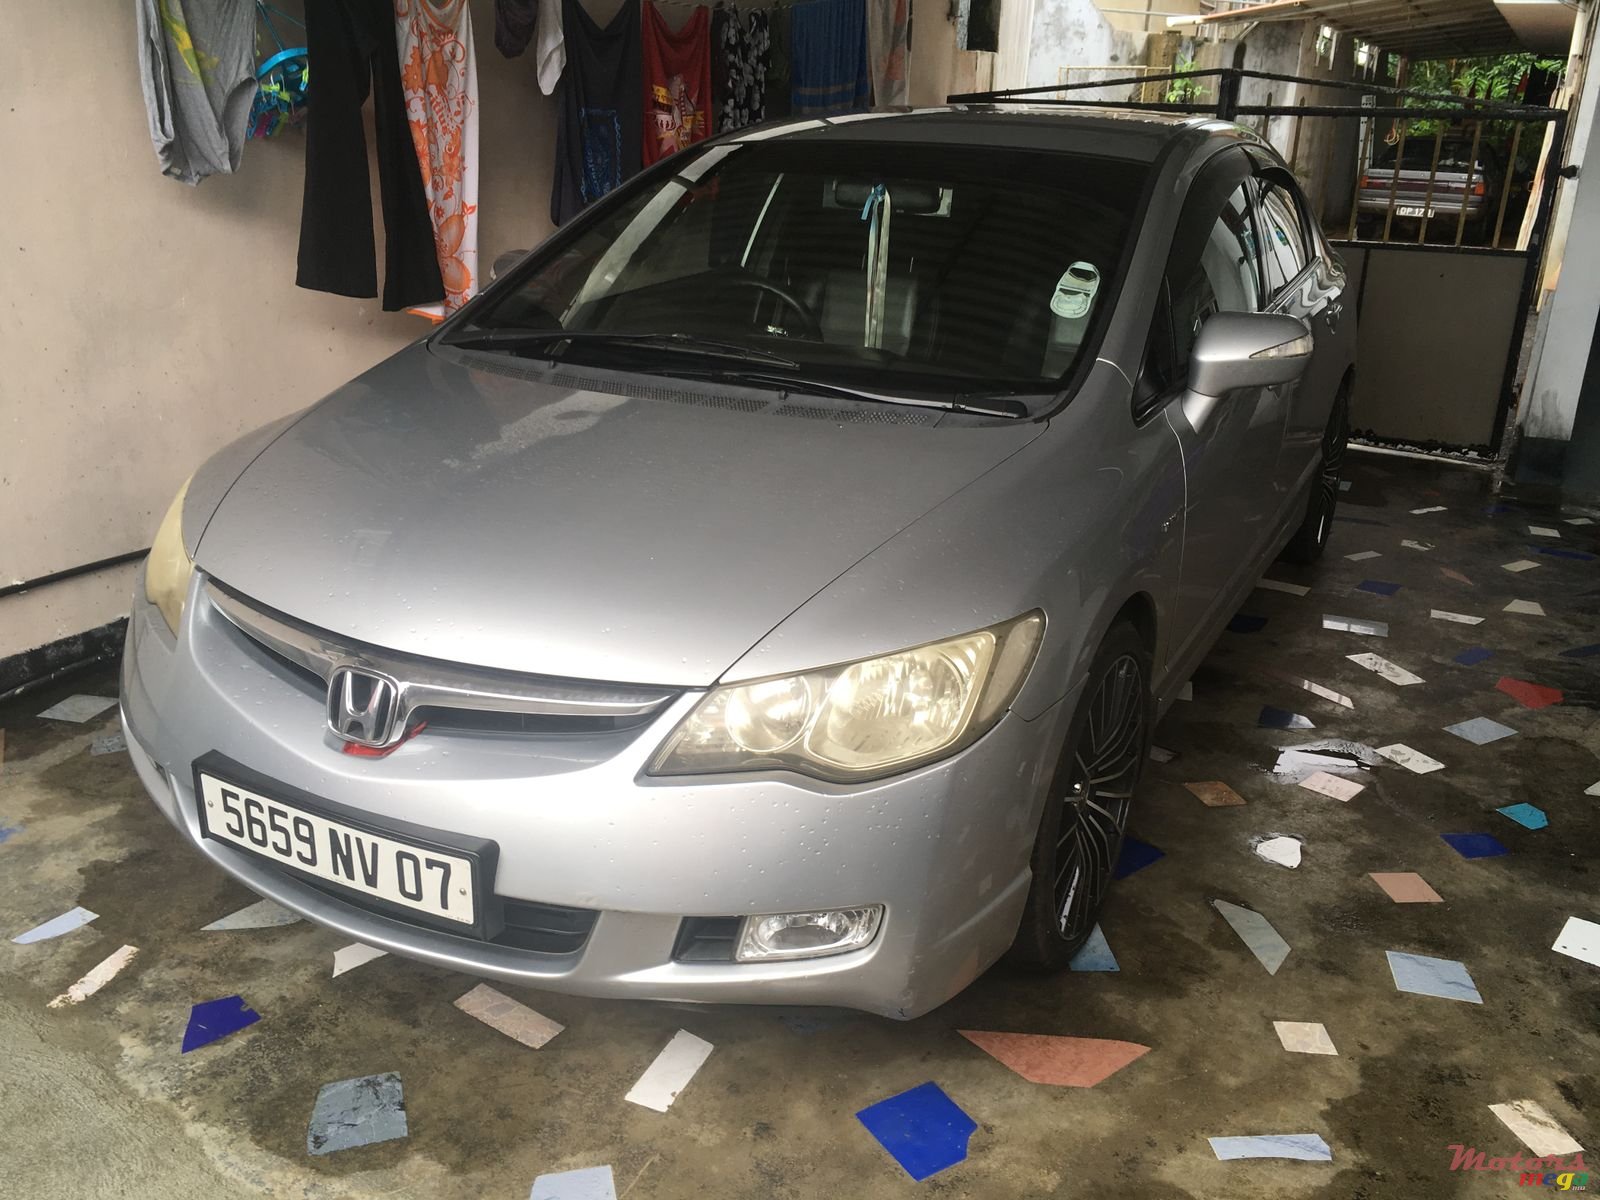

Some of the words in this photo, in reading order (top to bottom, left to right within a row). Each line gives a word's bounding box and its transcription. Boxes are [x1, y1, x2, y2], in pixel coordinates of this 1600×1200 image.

[221, 788, 317, 866] 5659
[328, 828, 379, 889] NV
[395, 850, 452, 910] 07
